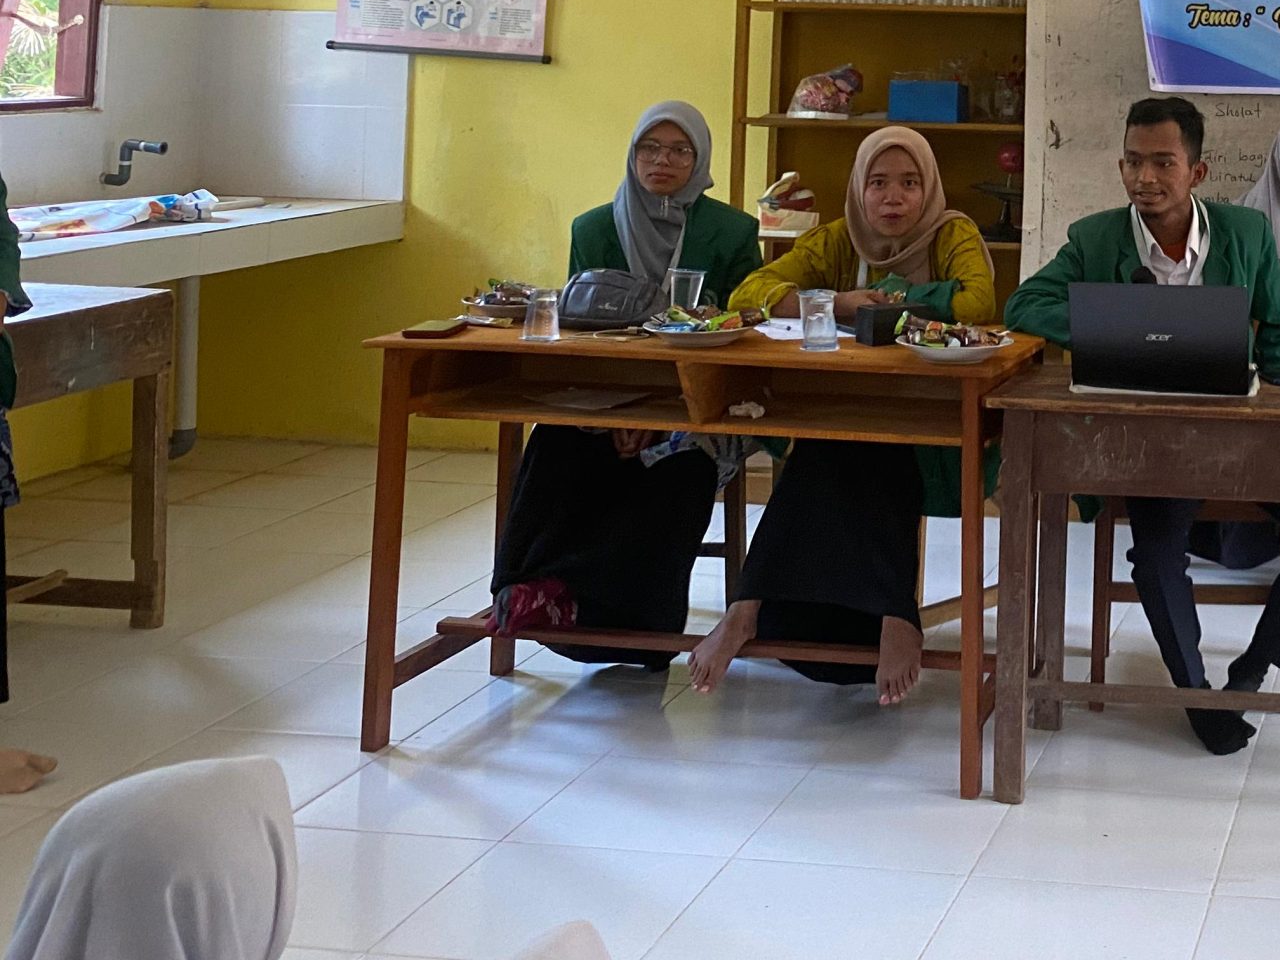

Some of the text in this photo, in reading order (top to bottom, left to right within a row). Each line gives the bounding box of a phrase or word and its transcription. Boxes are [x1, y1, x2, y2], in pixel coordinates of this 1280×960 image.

[1186, 4, 1240, 28] Tema
[1215, 102, 1262, 118] Sholat
[1146, 333, 1173, 342] acer
